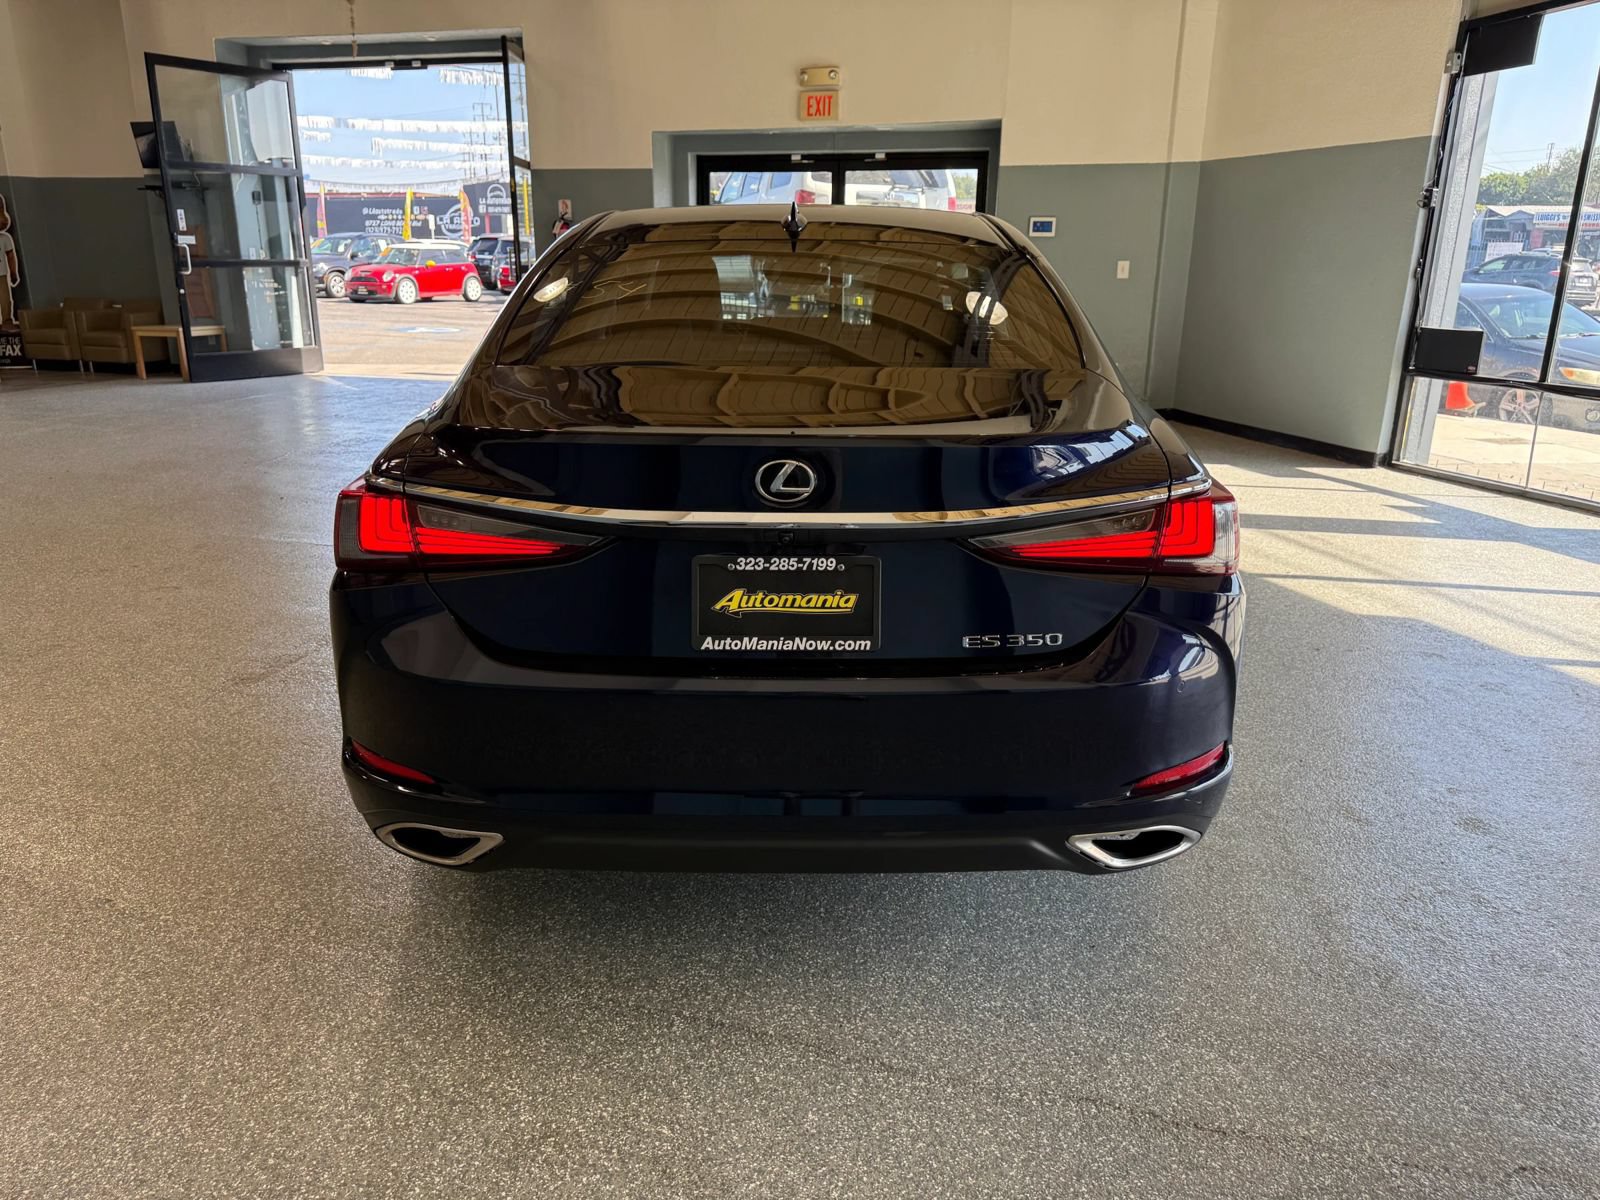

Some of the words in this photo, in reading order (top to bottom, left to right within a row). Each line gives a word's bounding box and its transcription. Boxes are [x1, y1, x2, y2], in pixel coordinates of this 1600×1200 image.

[807, 95, 833, 117] EXIT
[735, 557, 837, 571] 323-285-7199
[713, 588, 859, 610] Automania
[700, 636, 871, 651] AutoManiaNow.com
[962, 634, 1001, 648] ES
[1006, 633, 1063, 647] 350
